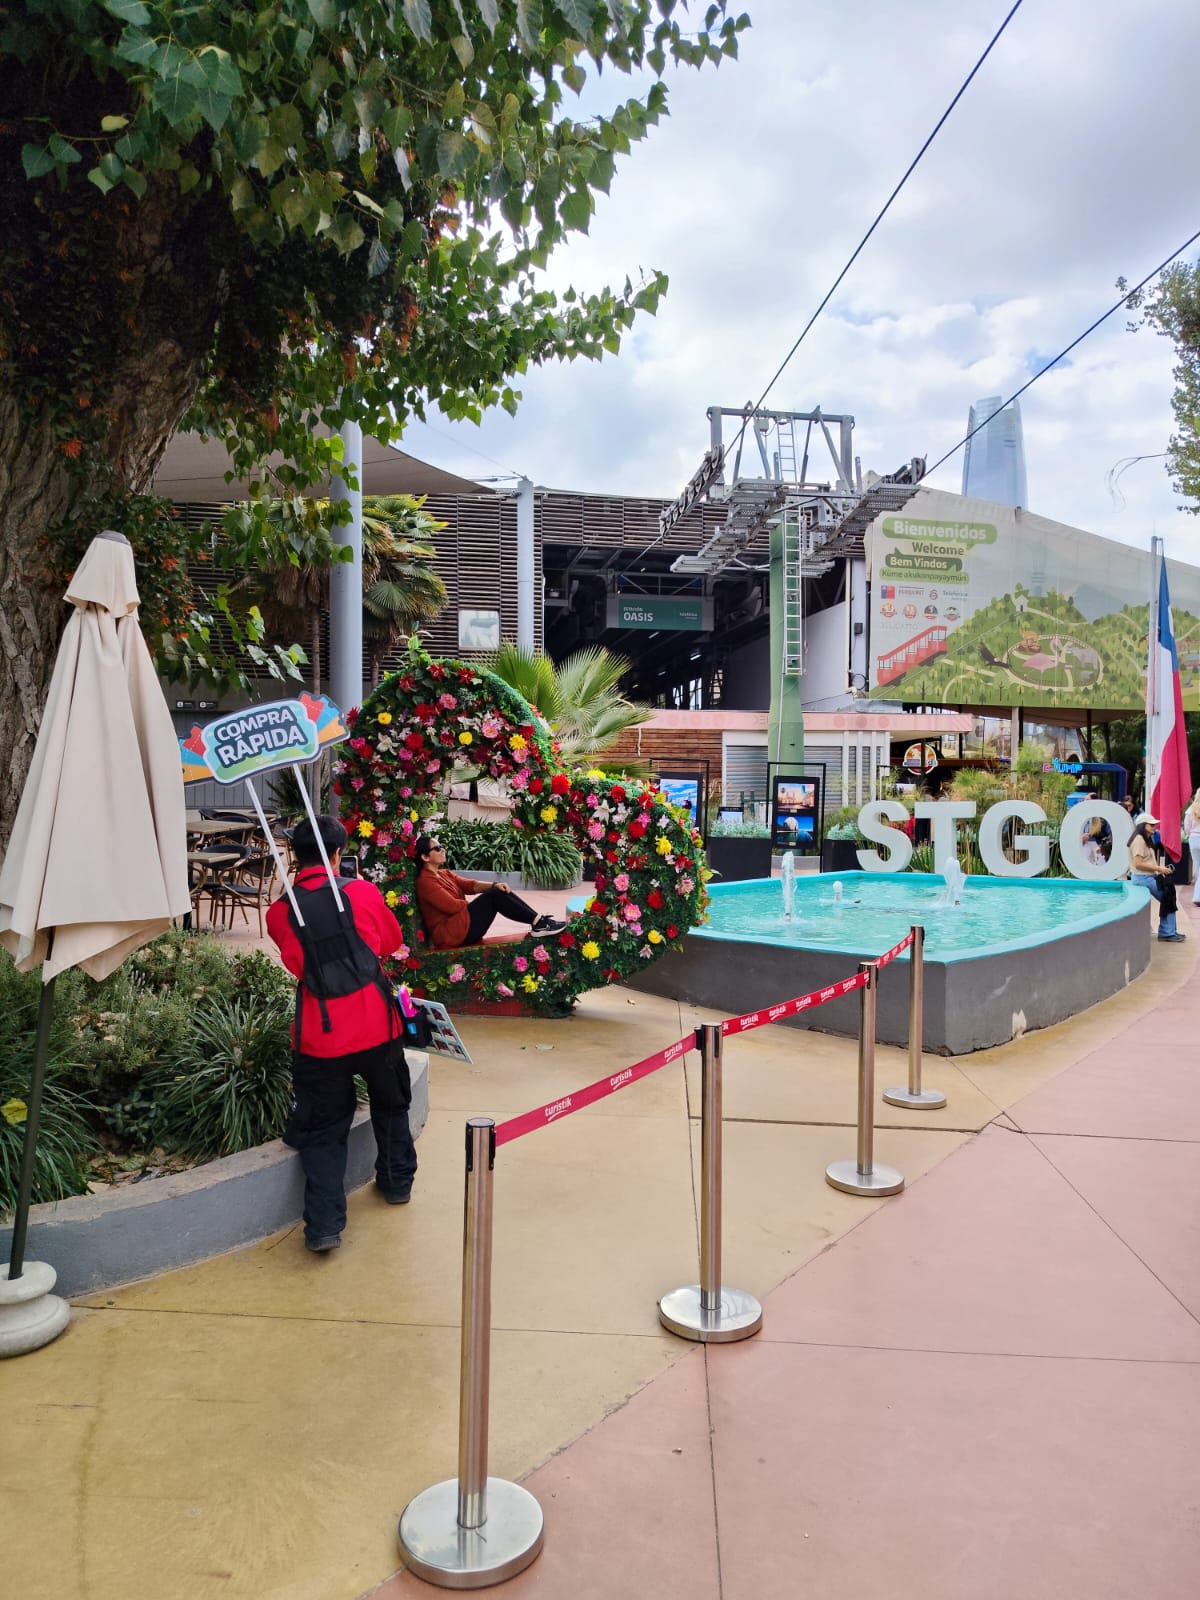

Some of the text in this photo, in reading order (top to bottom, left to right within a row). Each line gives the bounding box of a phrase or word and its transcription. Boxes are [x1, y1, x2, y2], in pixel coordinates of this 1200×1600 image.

[893, 520, 987, 540] Bienvenidos
[911, 542, 965, 556] Welcome
[890, 556, 948, 569] Bem Vindos
[623, 612, 654, 622] OASIS
[217, 708, 294, 741] COMPRA
[217, 725, 306, 766] RÁPIDA
[856, 799, 1133, 881] STGO
[769, 1005, 787, 1017] turistik
[740, 1014, 759, 1026] turistik
[664, 1043, 683, 1058] turistik
[610, 1068, 633, 1086] turistik
[544, 1097, 572, 1117] turistik
